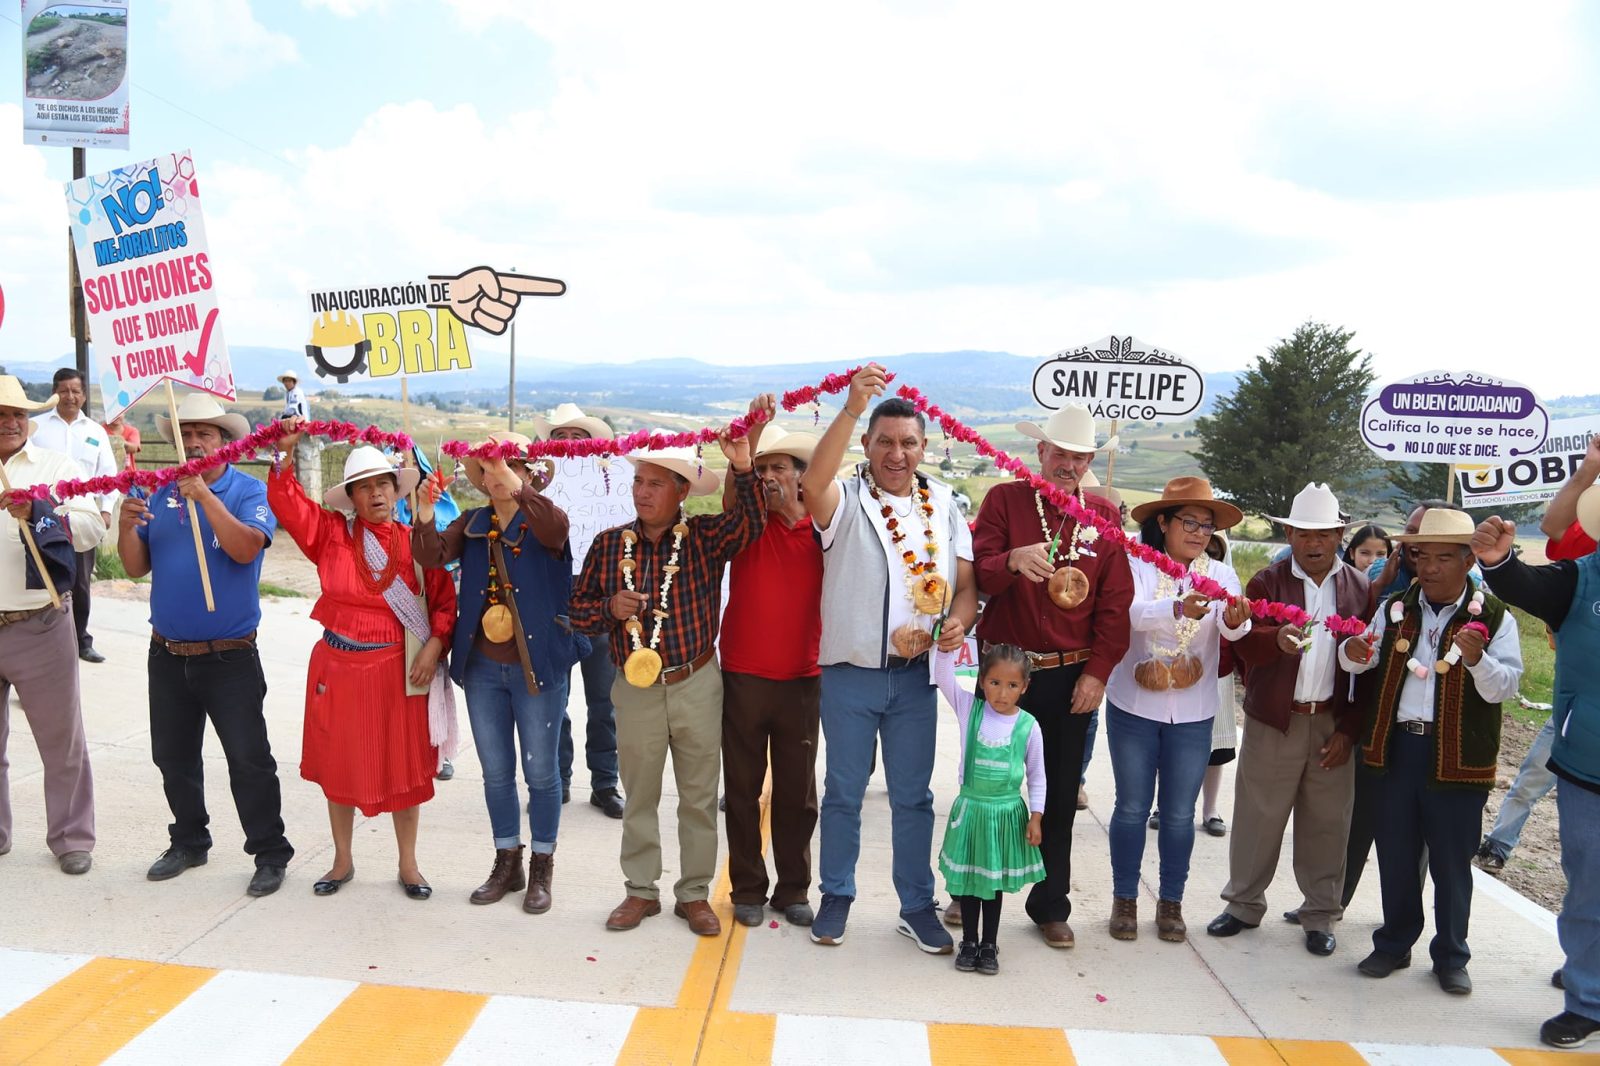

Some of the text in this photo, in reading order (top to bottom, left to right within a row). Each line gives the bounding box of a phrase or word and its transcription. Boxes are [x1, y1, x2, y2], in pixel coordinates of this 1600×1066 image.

[47, 104, 58, 112] LOS
[58, 104, 79, 112] DICHOS
[101, 167, 164, 236] NO!
[93, 220, 188, 267] MEJORALITOS
[84, 252, 213, 315] SOLUCIONES
[310, 281, 452, 313] INAUGURACIÓN DE
[112, 302, 199, 346] QUE DURAN
[111, 355, 123, 382] Y
[1051, 369, 1187, 402] SAN FELIPE
[1392, 392, 1522, 414] UN BUEN CIUDADANO
[1368, 418, 1539, 440] Califica lo que se hace,
[1404, 440, 1501, 458] NO LO QUE SE DICE.
